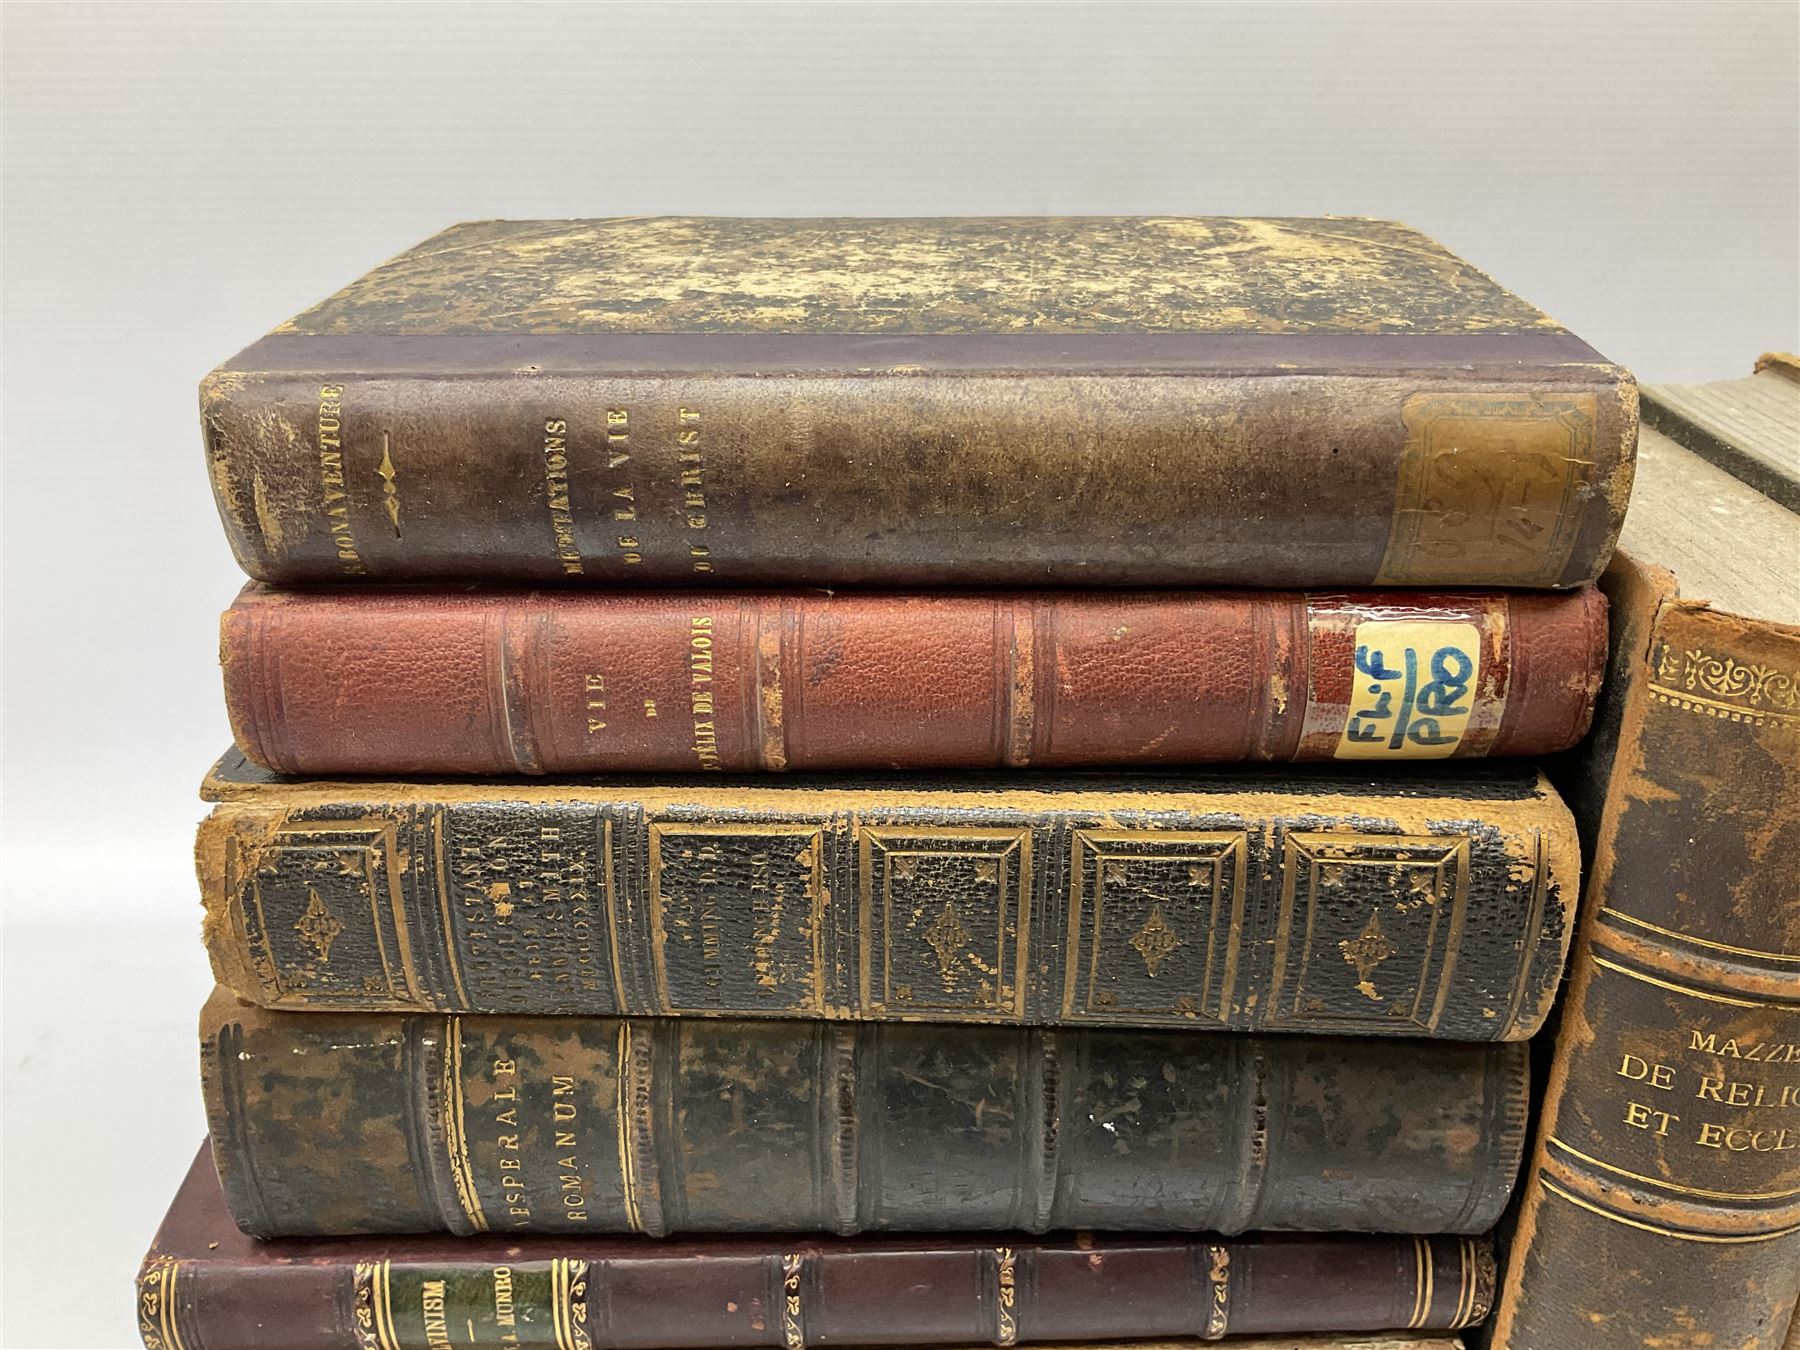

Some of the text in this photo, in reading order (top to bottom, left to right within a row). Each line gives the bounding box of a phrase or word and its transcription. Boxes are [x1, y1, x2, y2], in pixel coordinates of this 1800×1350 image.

[606, 409, 642, 564] DE LA VIE
[679, 408, 708, 529] CHRIST
[691, 616, 713, 682] VALOIS
[585, 673, 608, 734] VIE
[644, 698, 657, 718] DE
[692, 692, 713, 714] DE
[1408, 646, 1472, 745] PRO
[487, 836, 525, 1003] DISCUSSON
[1616, 1055, 1676, 1091] DE
[492, 1059, 530, 1227] VESPERALE
[552, 1075, 587, 1221] ROMANUM
[1622, 1102, 1800, 1152] ET ECCL
[493, 1266, 516, 1327] MUNRO
